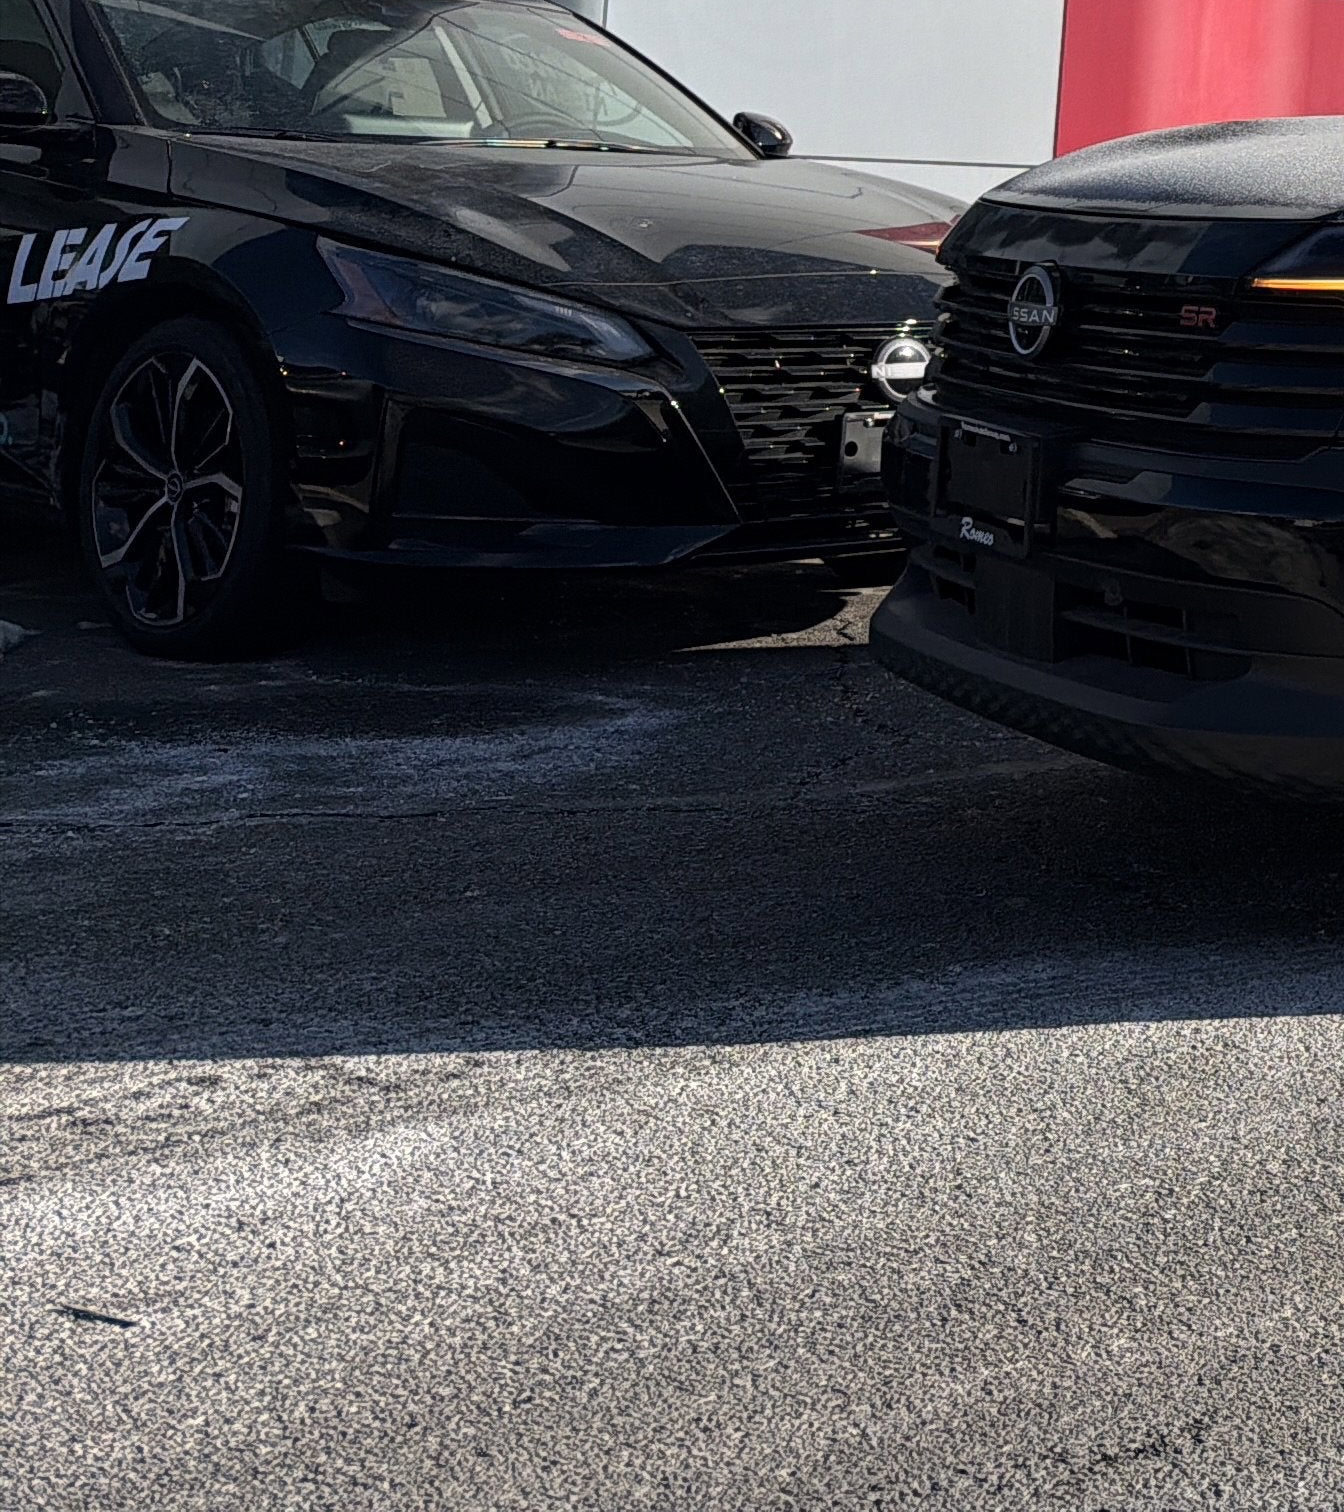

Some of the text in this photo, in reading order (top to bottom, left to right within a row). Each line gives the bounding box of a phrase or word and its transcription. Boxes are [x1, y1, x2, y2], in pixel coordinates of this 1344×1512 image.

[7, 217, 190, 304] LEASE
[1011, 306, 1055, 324] SSAN
[1180, 305, 1217, 327] SR
[960, 516, 995, 546] Romeo
